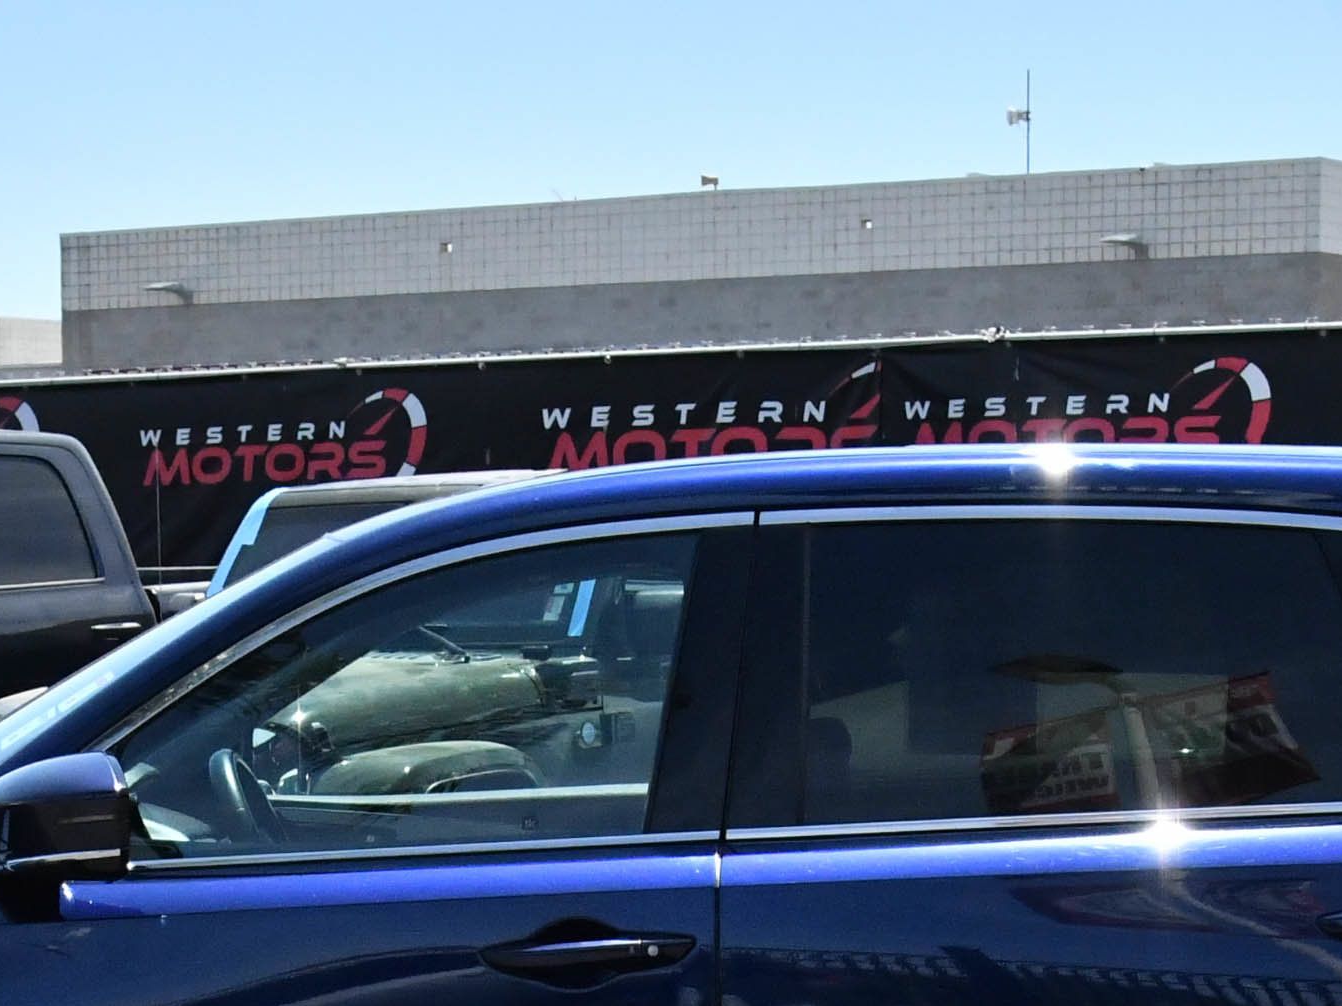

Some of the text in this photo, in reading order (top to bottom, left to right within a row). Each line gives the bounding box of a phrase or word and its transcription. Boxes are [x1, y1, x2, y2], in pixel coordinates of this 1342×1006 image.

[542, 400, 826, 430] WESTERN
[905, 393, 1170, 420] WESTERN
[140, 420, 346, 447] WESTERN
[143, 440, 387, 487] MOTORS
